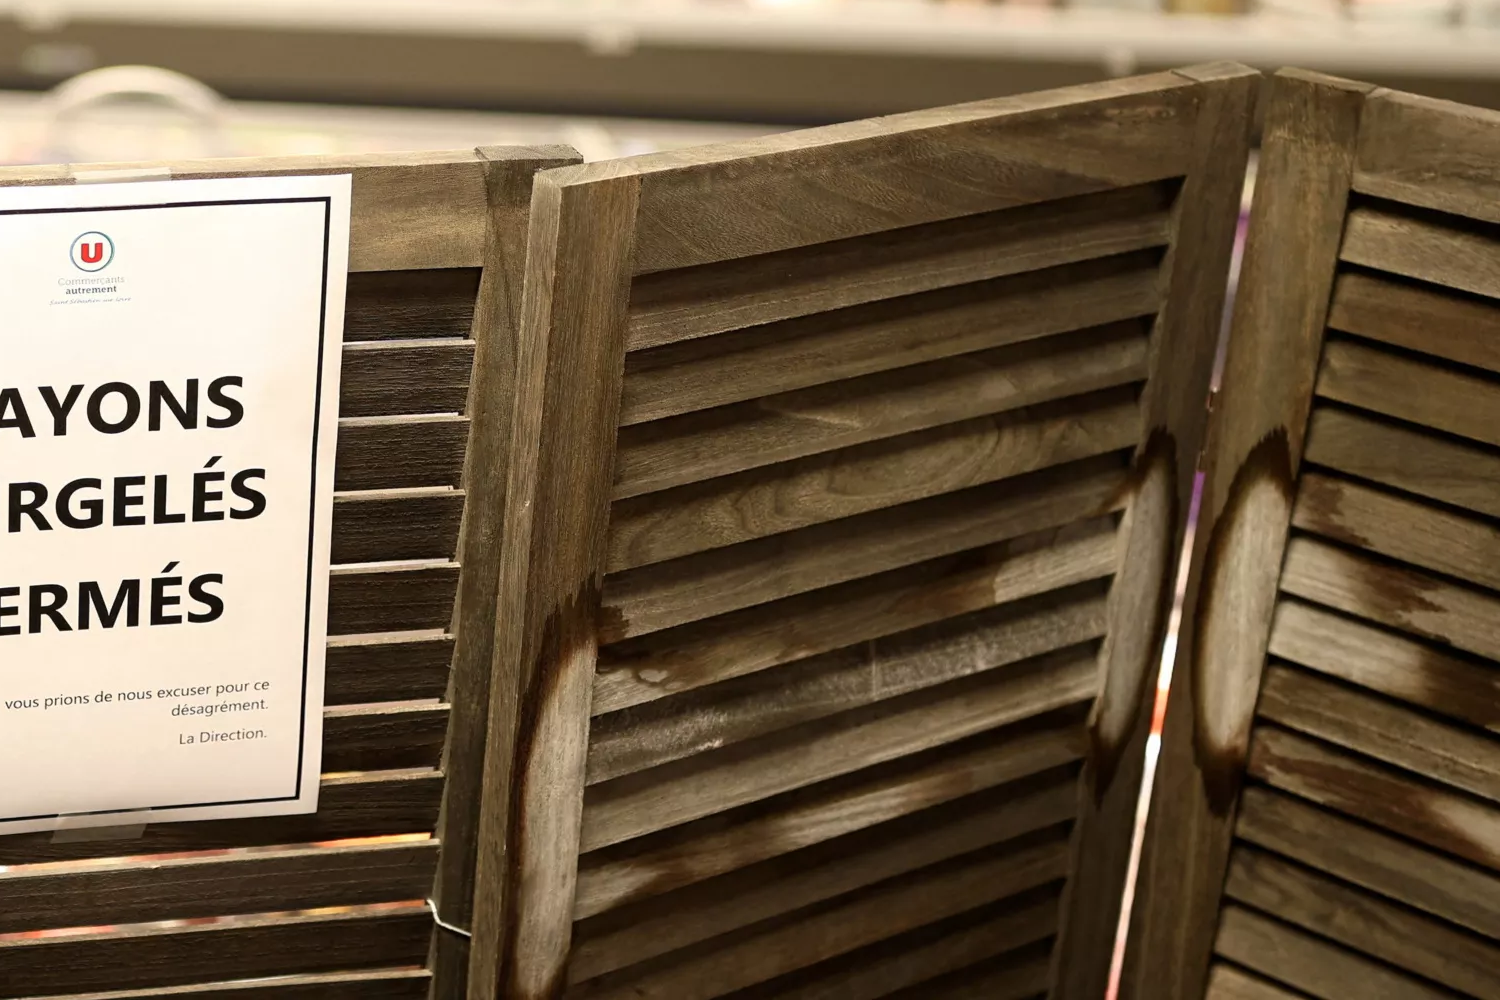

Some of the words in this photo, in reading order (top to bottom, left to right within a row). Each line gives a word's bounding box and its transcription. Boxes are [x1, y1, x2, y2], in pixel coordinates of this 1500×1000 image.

[80, 242, 103, 263] U
[57, 276, 125, 287] Commerçants
[65, 285, 117, 295] autrement
[5, 698, 40, 710] vous
[44, 693, 90, 710] prions
[94, 690, 114, 704] de
[117, 688, 152, 702] nous
[156, 684, 212, 699] excuser
[215, 680, 250, 695] pour
[253, 680, 270, 692] ce
[171, 699, 269, 718] désagrément.
[179, 733, 194, 745] La
[199, 729, 267, 744] Direction.
